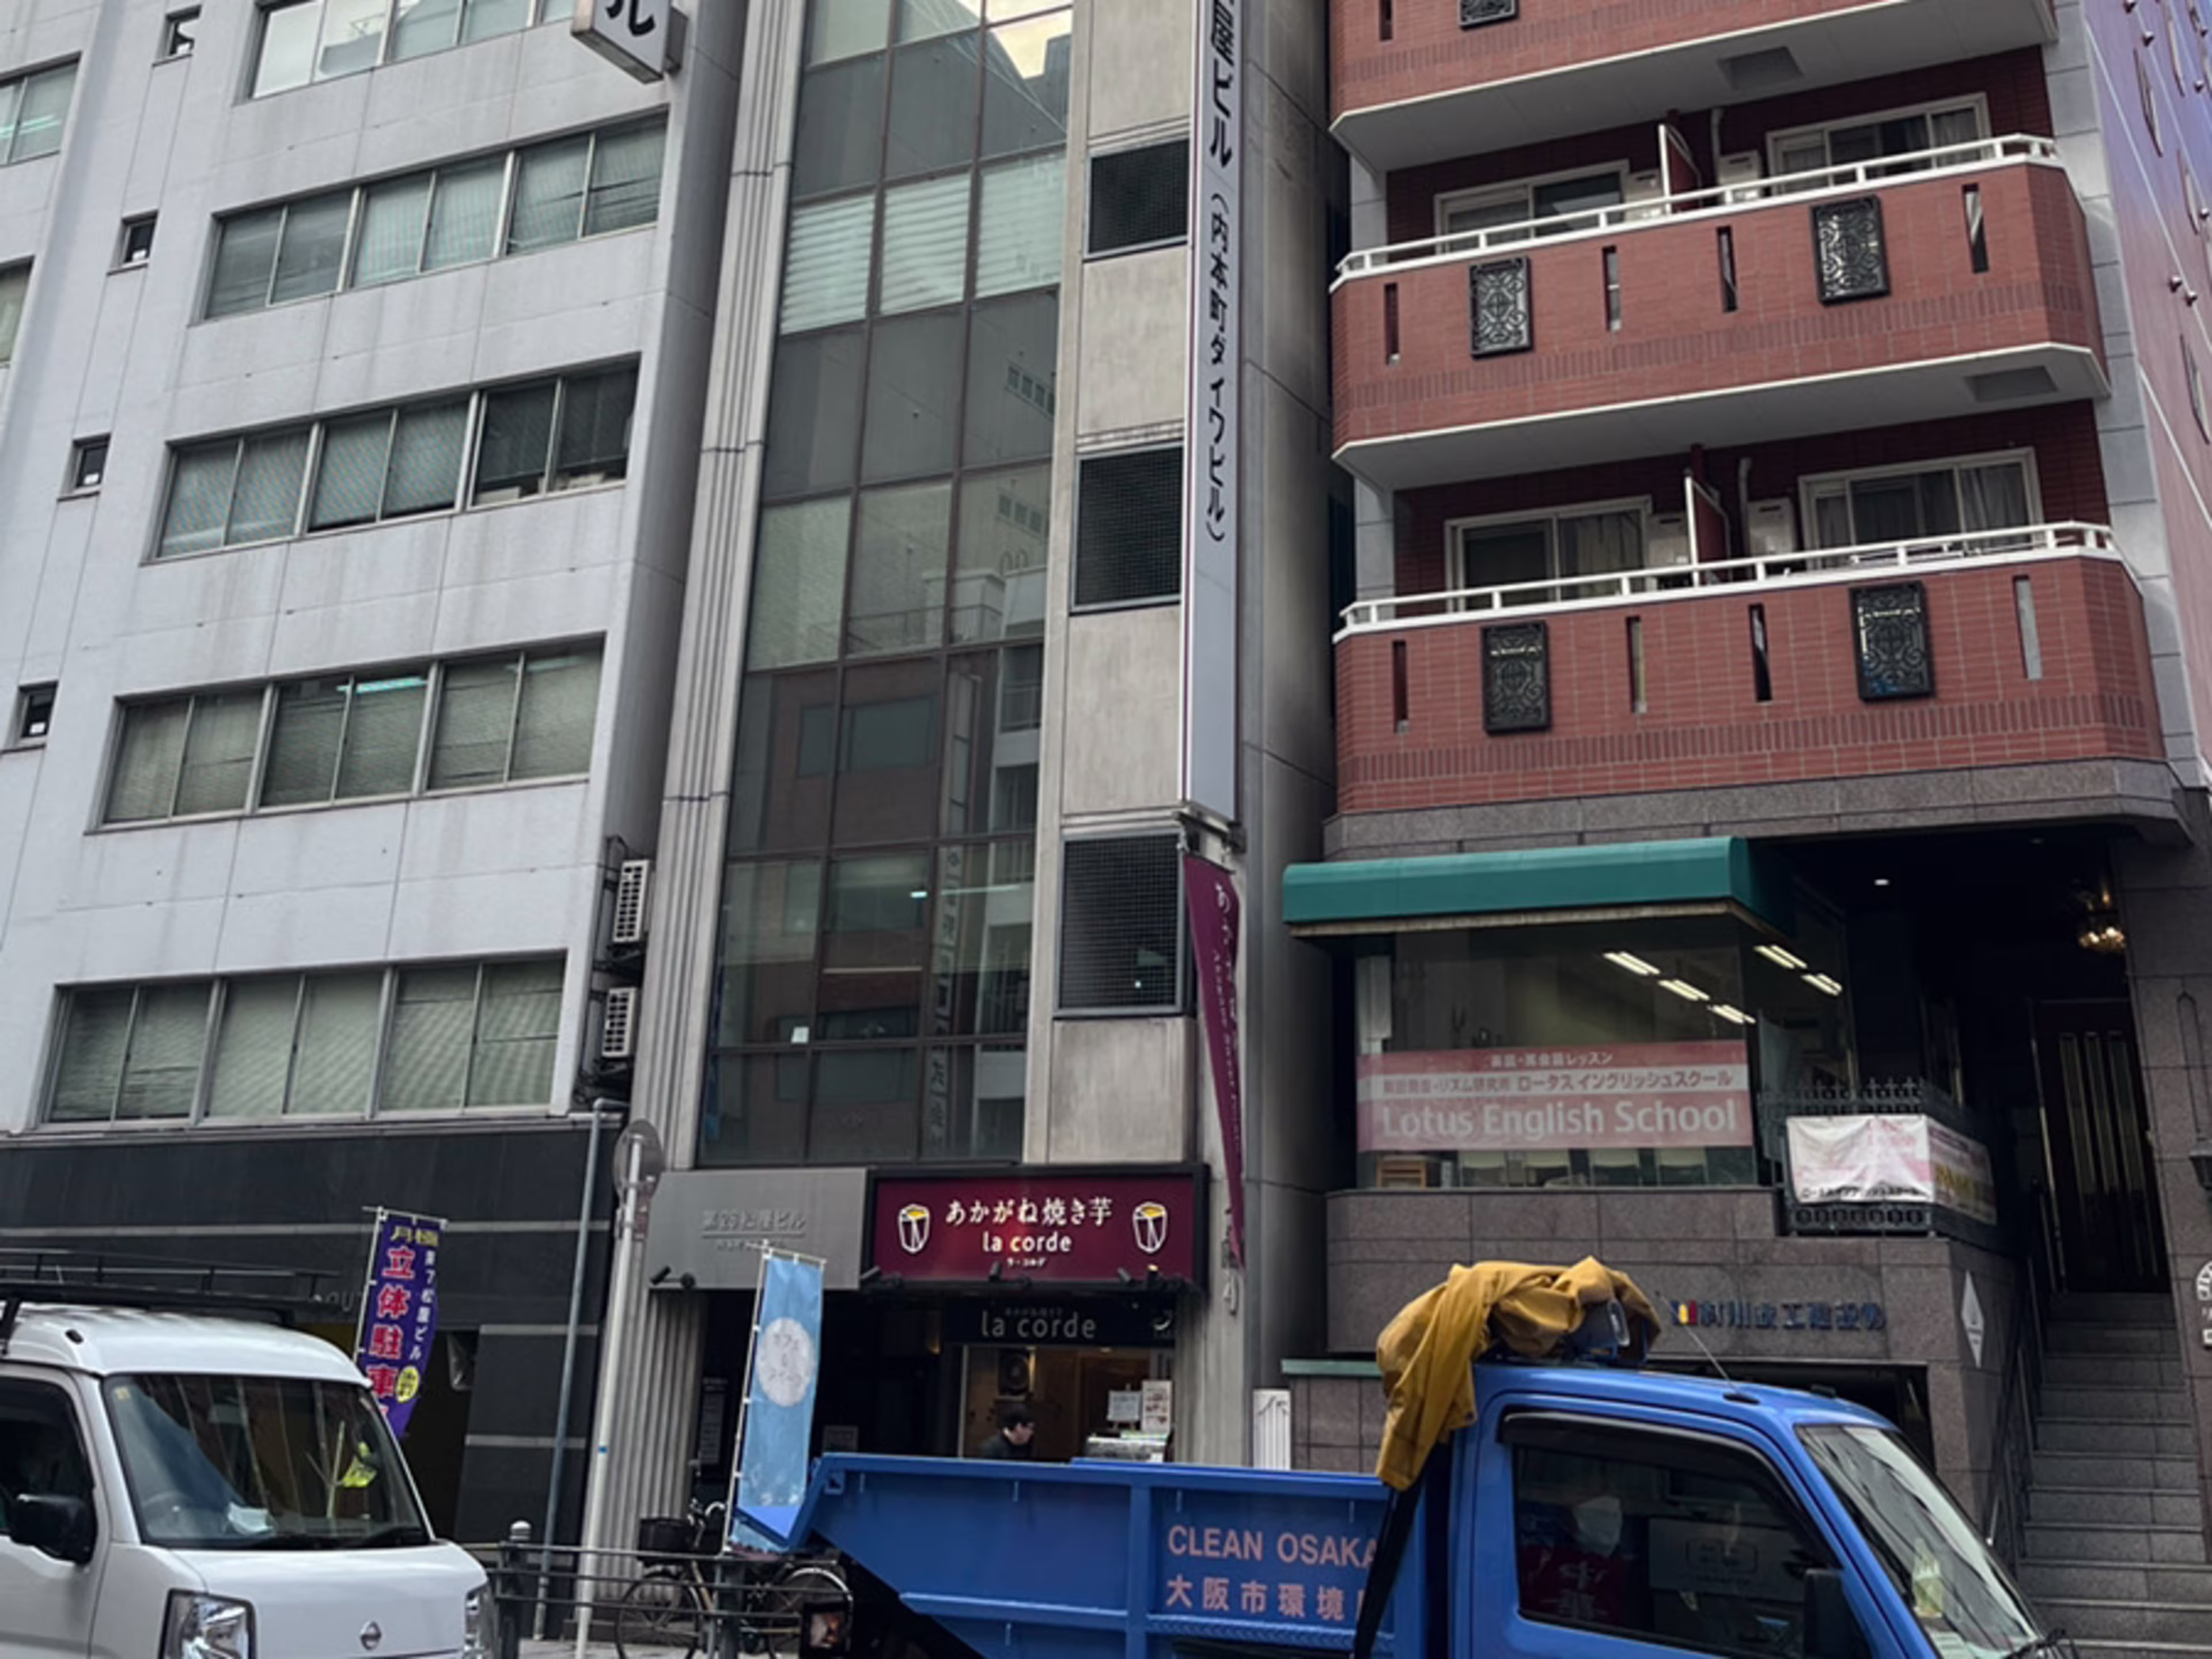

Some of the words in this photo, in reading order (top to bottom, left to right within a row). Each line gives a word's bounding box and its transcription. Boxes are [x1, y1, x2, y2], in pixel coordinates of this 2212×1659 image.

[1383, 1105, 1474, 1138] Lotus
[1483, 1101, 1605, 1141] English
[1615, 1098, 1736, 1134] School
[945, 1196, 1113, 1226] あかがね焼き芋
[983, 1231, 1003, 1252] la
[1009, 1230, 1073, 1252] corde
[982, 1310, 1004, 1337] la
[1017, 1311, 1097, 1339] corde
[1168, 1525, 1263, 1561] CLEAN
[1165, 1573, 1366, 1621] 大阪市環境
